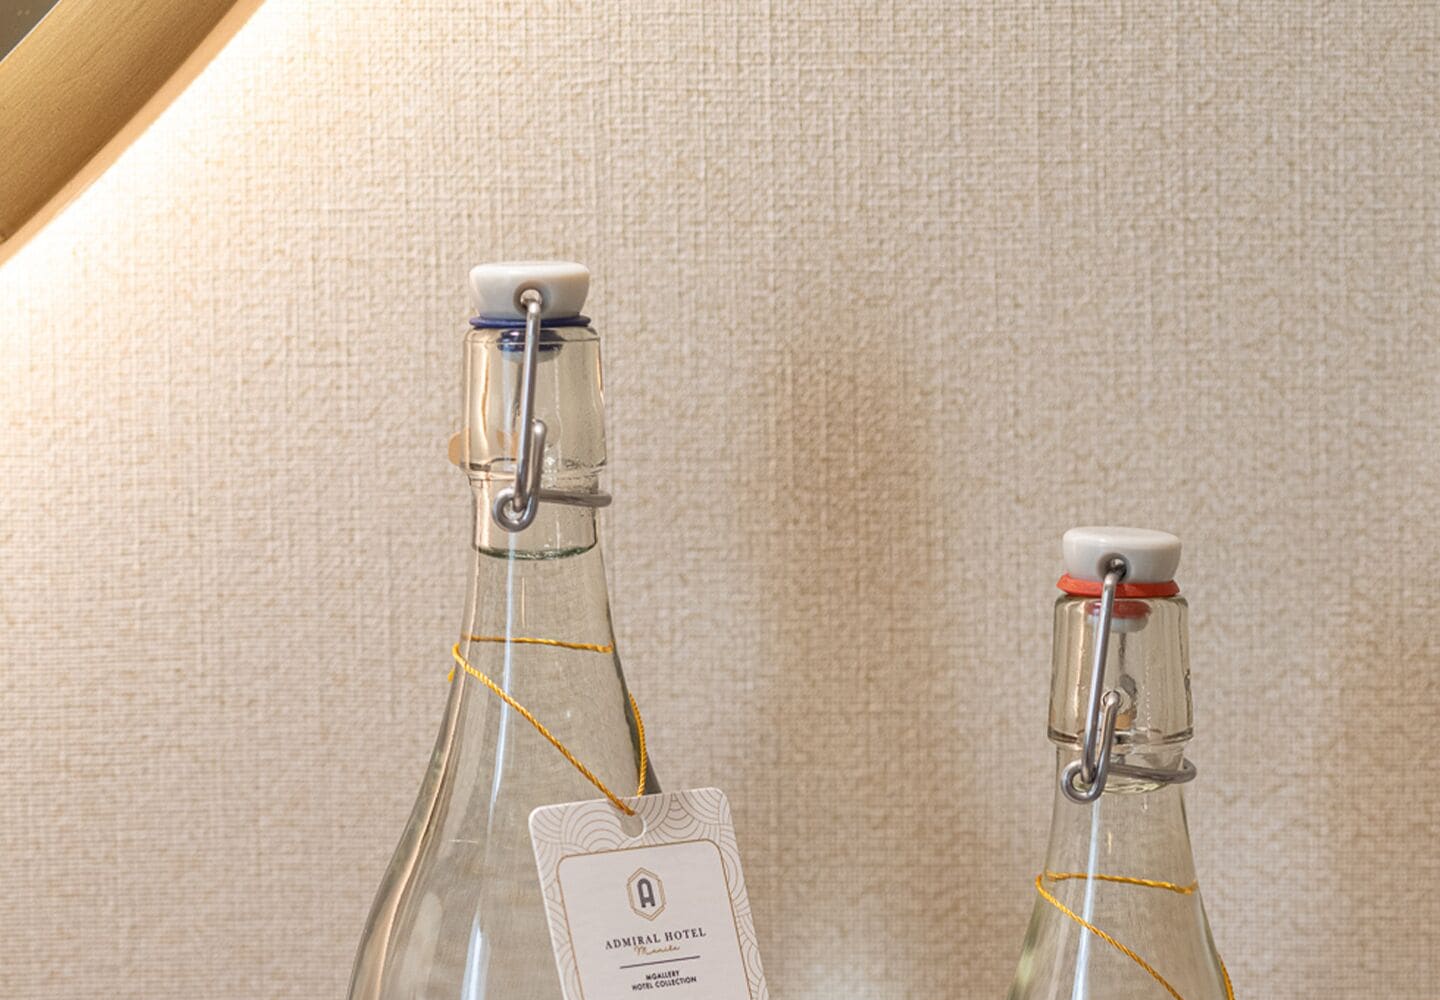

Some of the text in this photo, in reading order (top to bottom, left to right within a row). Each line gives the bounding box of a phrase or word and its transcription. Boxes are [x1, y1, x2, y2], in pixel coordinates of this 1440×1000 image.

[605, 927, 706, 950] ADMIRAL HOTEL
[632, 976, 697, 991] HOTEL COLLECTION
